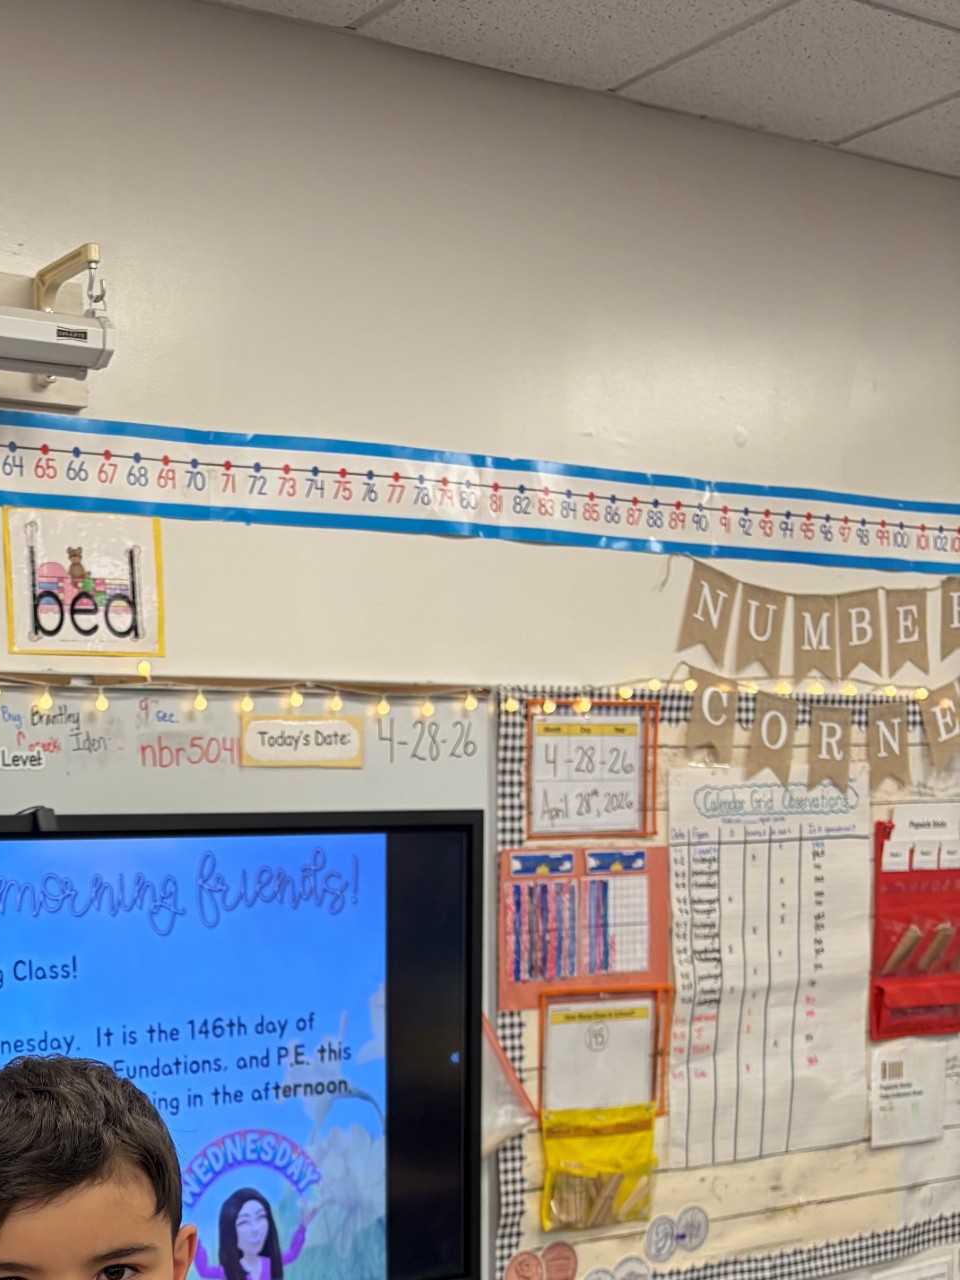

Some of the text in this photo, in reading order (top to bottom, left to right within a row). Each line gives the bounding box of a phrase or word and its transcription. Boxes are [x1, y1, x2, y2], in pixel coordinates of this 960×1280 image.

[34, 456, 57, 480] 65
[185, 468, 206, 491] 70
[248, 475, 268, 496] 72
[333, 480, 353, 501] 75
[513, 497, 531, 515] 82
[583, 503, 600, 522] 85
[893, 531, 910, 549] 100
[26, 540, 141, 641] bed
[258, 730, 352, 750] Today's Date:
[12, 956, 79, 983] Class!
[96, 1026, 115, 1048] It
[121, 1024, 138, 1046] is
[146, 1022, 180, 1043] the
[187, 1017, 249, 1041] 146th
[254, 1015, 289, 1044] day
[295, 1012, 316, 1034] of
[236, 1048, 270, 1070] and
[277, 1045, 310, 1068] P.E.
[317, 1041, 352, 1063] this
[187, 1088, 203, 1108] in
[211, 1084, 244, 1105] the
[251, 1078, 353, 1101] afternoon.
